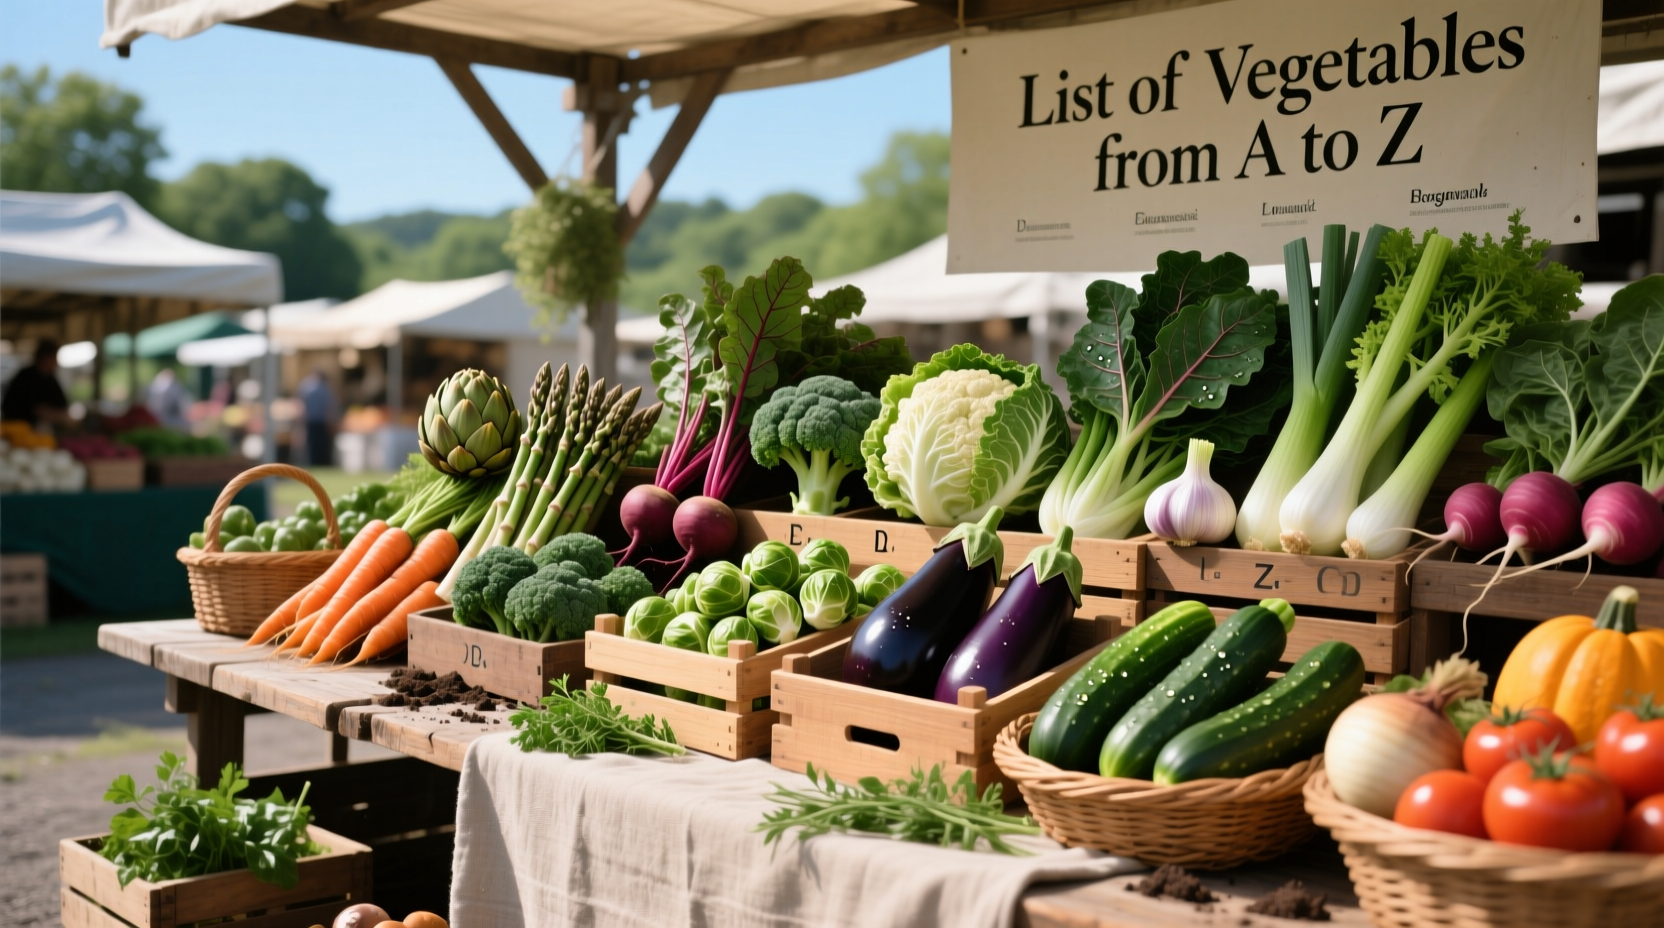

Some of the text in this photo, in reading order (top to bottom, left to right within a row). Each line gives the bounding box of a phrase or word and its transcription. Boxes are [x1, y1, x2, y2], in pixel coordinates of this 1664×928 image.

[1018, 11, 1525, 128] List of Vegetables
[1093, 102, 1424, 192] from A to Z
